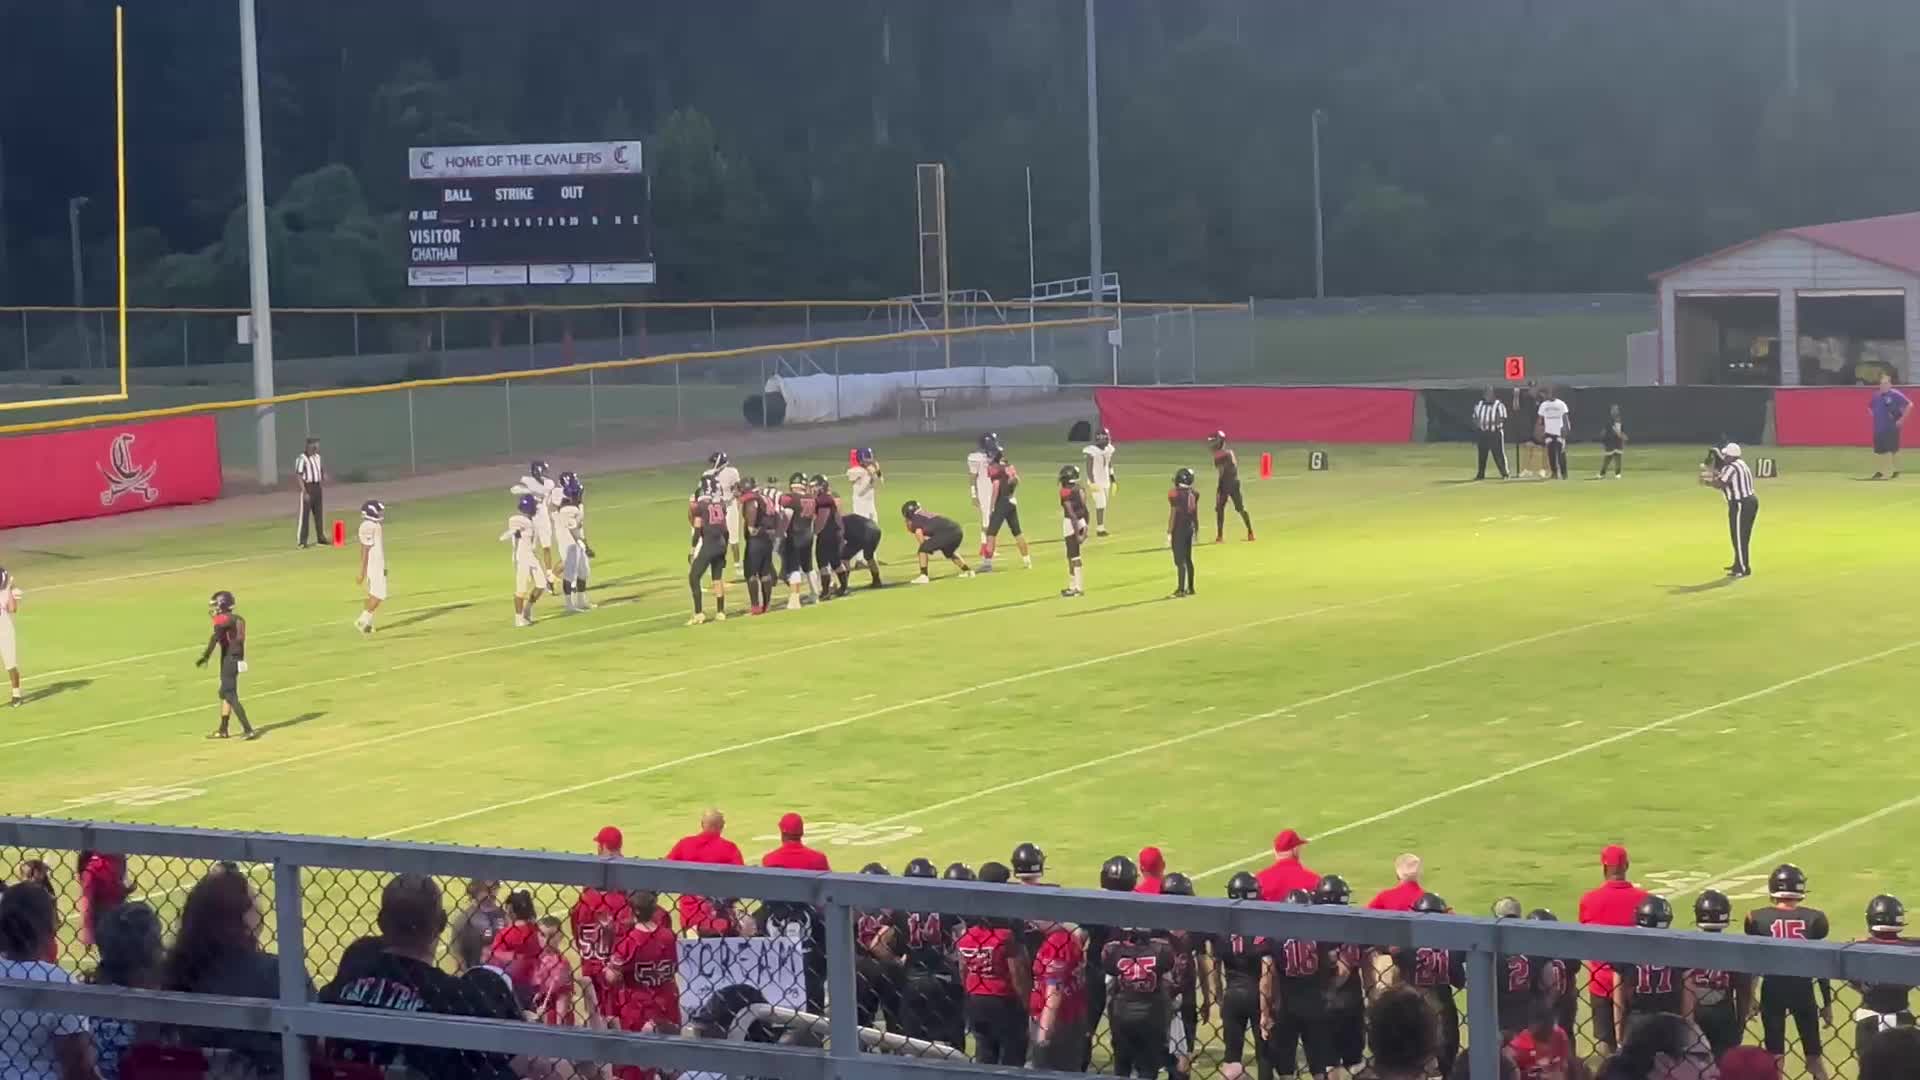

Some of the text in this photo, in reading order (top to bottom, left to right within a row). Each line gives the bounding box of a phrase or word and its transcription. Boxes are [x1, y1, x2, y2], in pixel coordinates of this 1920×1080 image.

[445, 152, 602, 168] HOME OF THE CAVALIERS
[444, 186, 584, 202] BALL STRIKE OUT
[408, 210, 438, 221] AT BAT
[569, 215, 579, 226] 10
[409, 228, 461, 244] VISITOR
[412, 246, 458, 261] CHATHAM
[1311, 452, 1323, 470] G
[1757, 458, 1774, 477] 10
